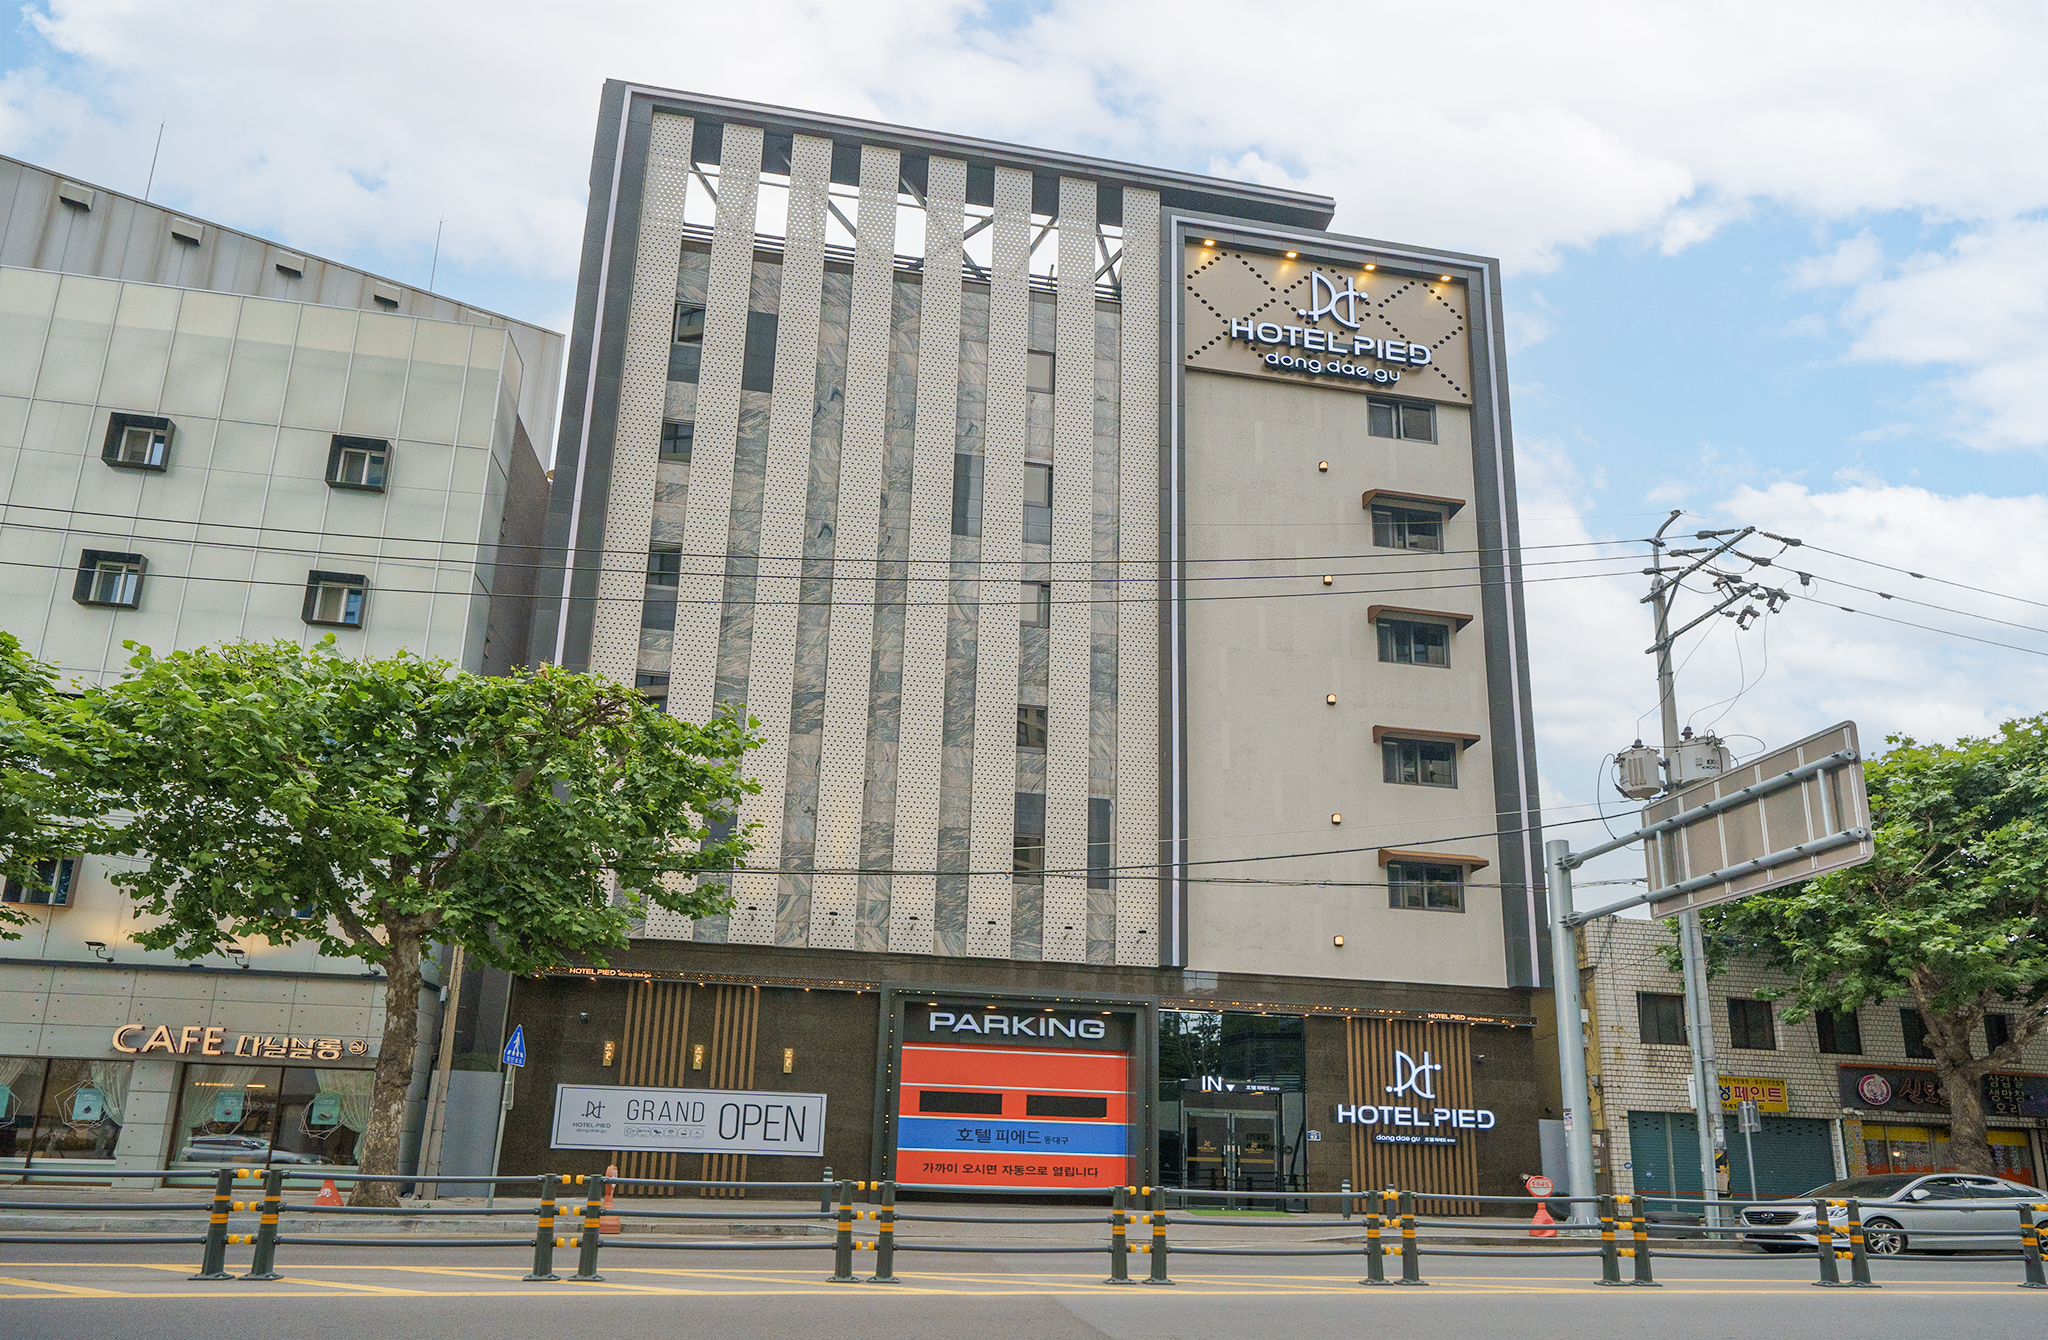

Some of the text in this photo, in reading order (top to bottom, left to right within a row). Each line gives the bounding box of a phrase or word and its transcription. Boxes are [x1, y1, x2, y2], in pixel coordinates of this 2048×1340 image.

[1231, 317, 1432, 365] HOTEL PIED
[1265, 351, 1401, 382] dong dae gu
[569, 967, 597, 976] HOTEL
[597, 968, 617, 976] PIED
[929, 1011, 1106, 1039] PARKING
[1427, 1012, 1450, 1020] HOTEL
[1450, 1013, 1466, 1021] PIED
[112, 1024, 228, 1056] CAFE
[1201, 1075, 1222, 1092] IN
[626, 1099, 807, 1143] GRAND OPEN
[1337, 1104, 1496, 1129] HOTEL PIED
[955, 1127, 1069, 1145] 호텔 피에드 동대구
[1375, 1134, 1395, 1143] dong
[1396, 1134, 1411, 1142] dae
[922, 1162, 1099, 1178] 가까이 오시면 자동으로 열립니다
